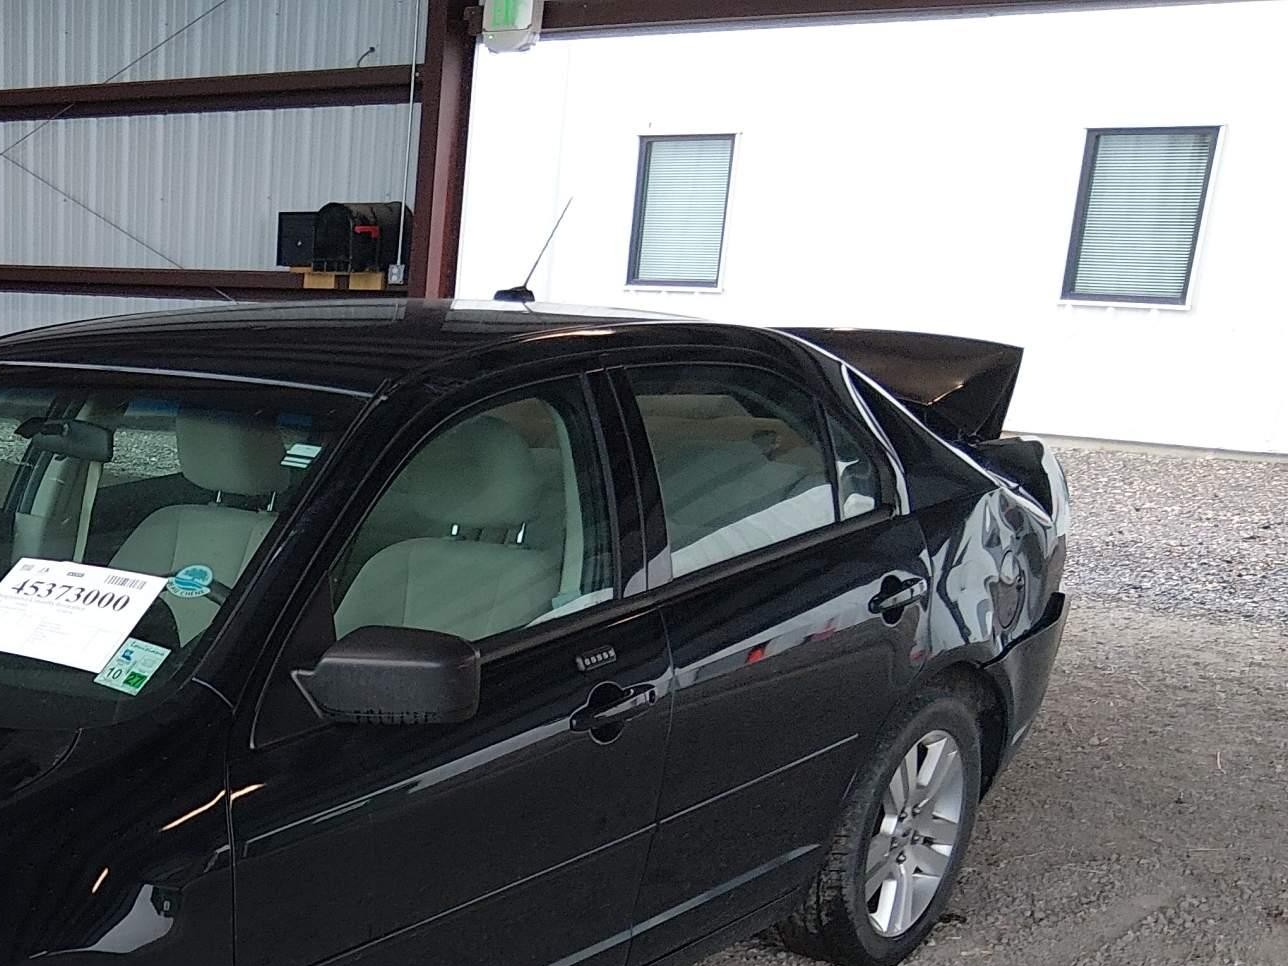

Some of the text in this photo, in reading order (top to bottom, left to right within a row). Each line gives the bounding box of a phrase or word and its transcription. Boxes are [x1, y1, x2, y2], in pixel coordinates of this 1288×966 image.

[11, 579, 131, 612] 45373000
[106, 667, 123, 681] 10
[127, 672, 146, 686] 27
